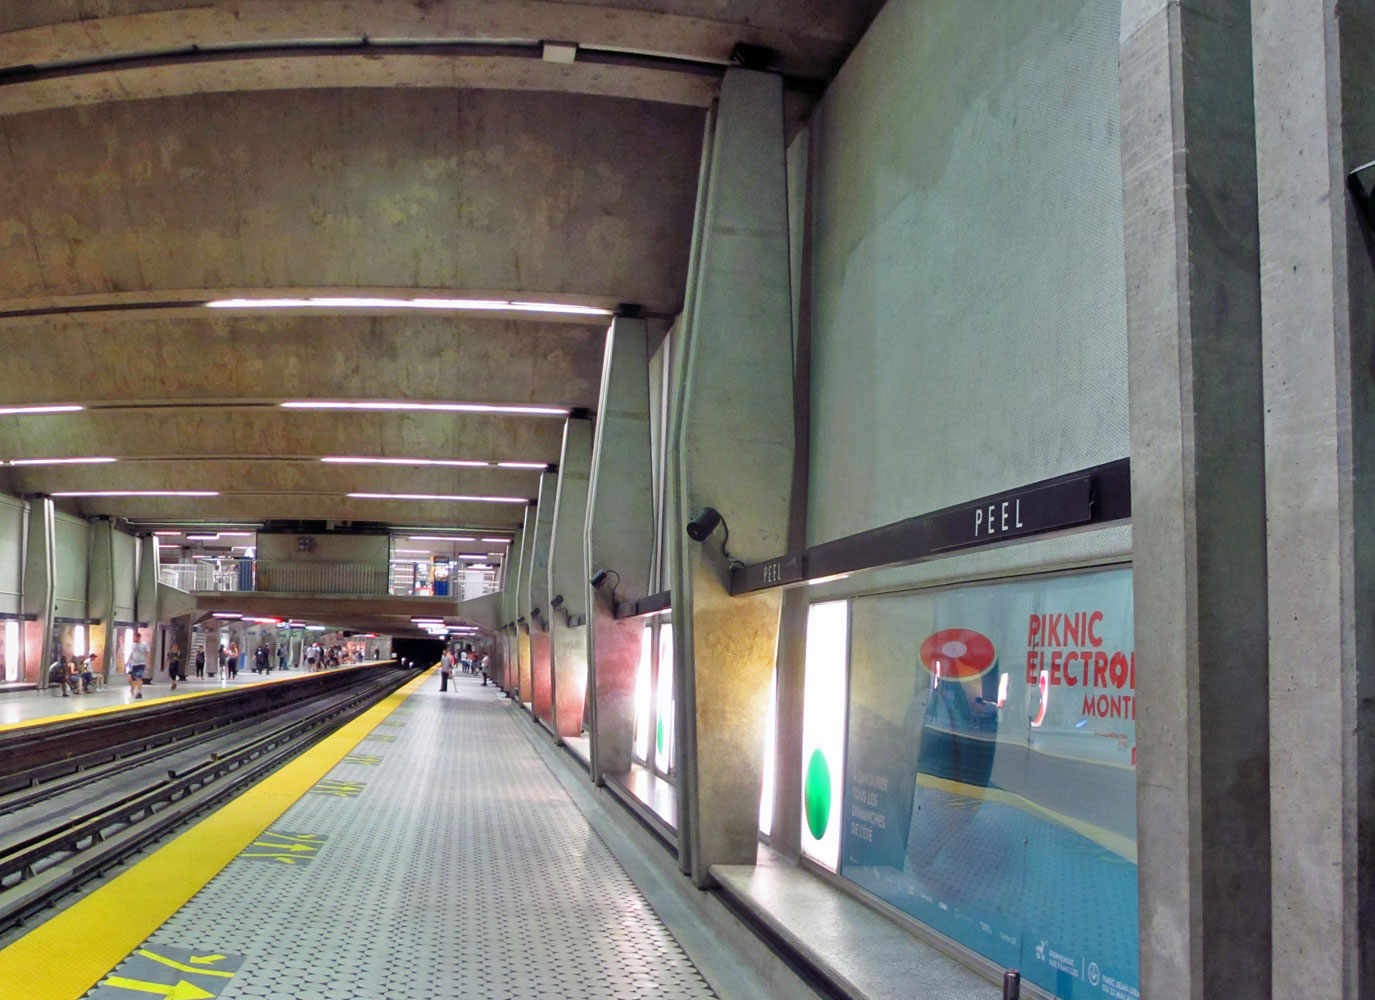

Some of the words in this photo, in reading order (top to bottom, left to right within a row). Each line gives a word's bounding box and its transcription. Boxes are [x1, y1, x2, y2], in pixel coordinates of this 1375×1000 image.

[975, 499, 1023, 536] PEEL
[763, 563, 781, 583] PEEL
[1028, 611, 1104, 647] PIKNIC
[1082, 694, 1136, 720] MONT
[851, 804, 886, 829] DIMANCHES
